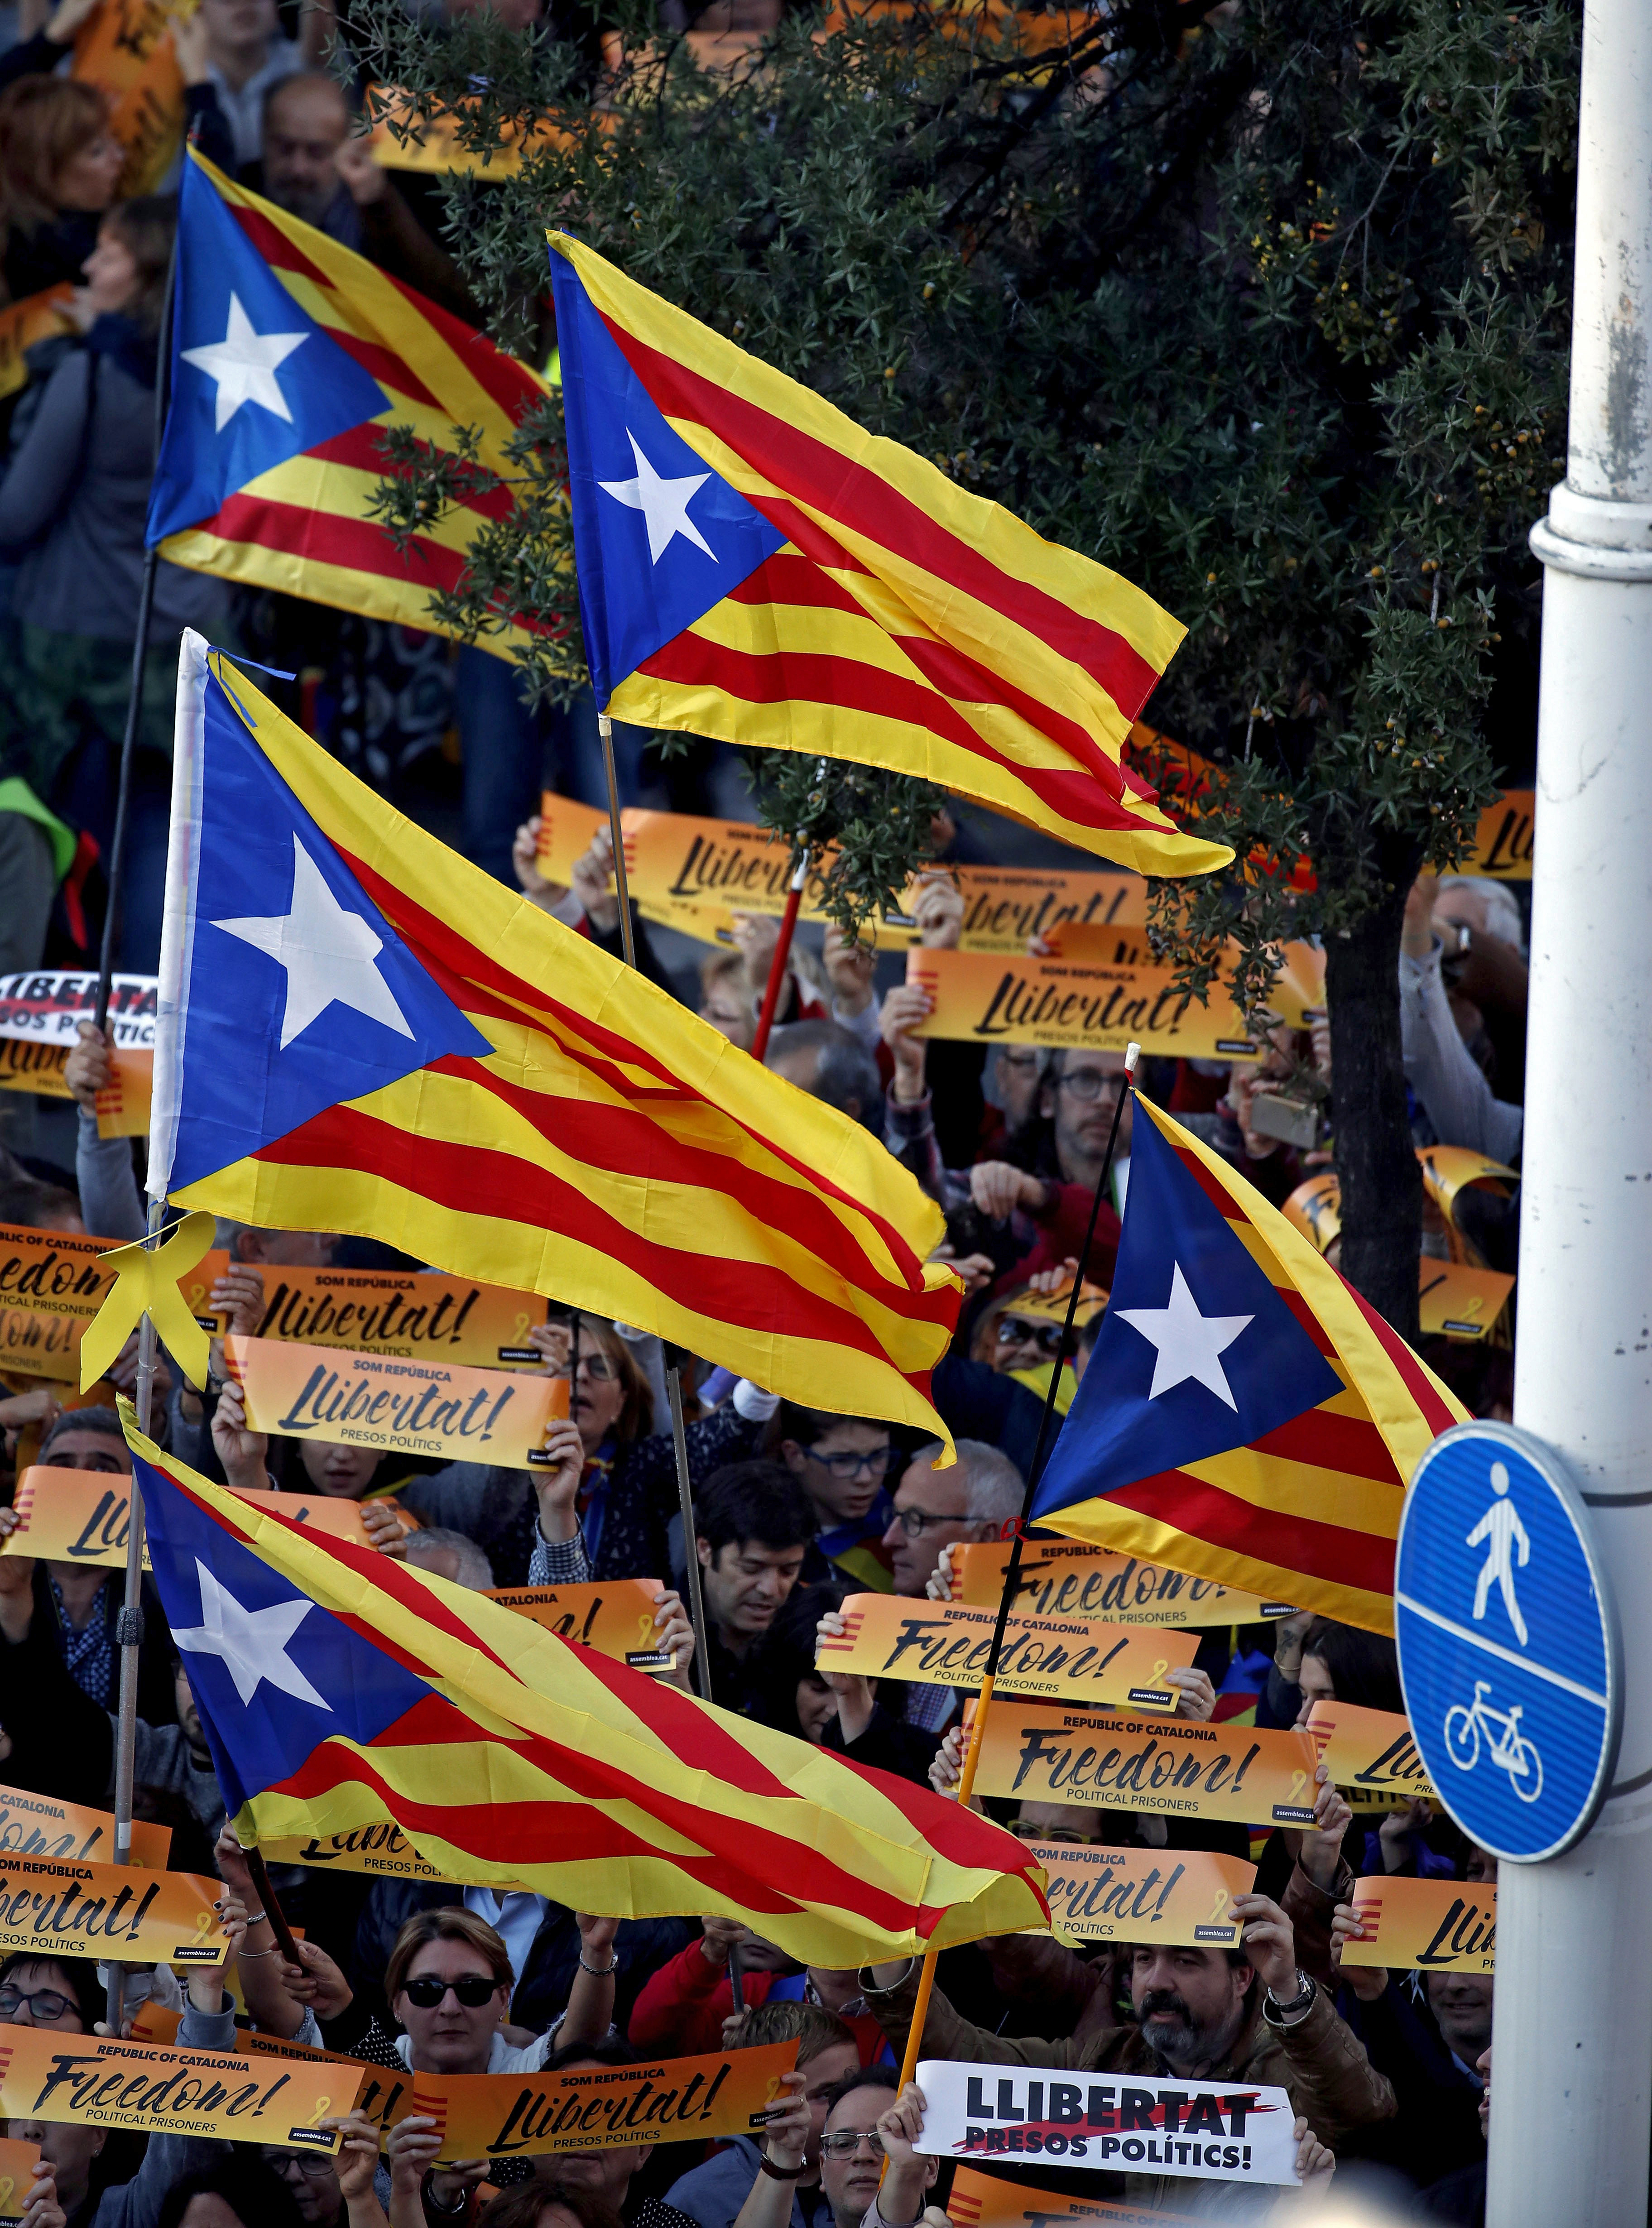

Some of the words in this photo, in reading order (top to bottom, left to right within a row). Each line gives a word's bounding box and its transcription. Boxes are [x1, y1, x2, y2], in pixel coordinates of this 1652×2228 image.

[26, 1236, 43, 1245] OF
[315, 1275, 344, 1287] SOM
[347, 1276, 415, 1290] REPÚBLICA
[353, 1359, 382, 1373] SOM
[385, 1364, 451, 1383] REPÚBLICA
[278, 1364, 515, 1442] Llibertat!
[341, 1428, 386, 1444] PRESOS
[389, 1435, 442, 1451] POLÍTICS
[1041, 1546, 1102, 1558] REPUBLIC
[489, 1593, 558, 1606] ATALONIA
[944, 1610, 997, 1624] REPUBLIC
[1006, 1618, 1020, 1628] OF
[1022, 1620, 1089, 1635] CATALONIA
[1119, 1612, 1187, 1623] PRISONERS
[629, 1653, 668, 1663] assemblea.cat
[882, 1620, 1129, 1679] Freedom!
[934, 1671, 984, 1684] POLITICA
[994, 1678, 1060, 1692] PRISONERS
[1132, 1692, 1169, 1702] assemblea.cat
[1063, 1716, 1124, 1732] REPUBLIC
[1126, 1723, 1143, 1733] OF
[1146, 1724, 1217, 1742] CATALONIA
[1011, 1729, 1261, 1793] Freedom!
[0, 1794, 65, 1820] CATALONIA
[1067, 1788, 1128, 1804] POLITICAL
[1131, 1795, 1199, 1811] PRISONERS
[1276, 1810, 1314, 1819] assemblea.cat
[364, 1858, 411, 1873] PRESOS
[1061, 1851, 1126, 1865] REPÚBLICA
[23, 1862, 94, 1880] REPÚBLICA
[1046, 1863, 1186, 1923] ertat!
[1064, 1921, 1114, 1935] POLÍTICS
[30, 1936, 86, 1952] POLÍTICS
[250, 2039, 279, 2055] SOM
[97, 2045, 158, 2061] REPUBLIC
[159, 2052, 178, 2063] OF
[179, 2055, 250, 2072] CATALONIA
[32, 2055, 291, 2118] Freedom!
[561, 2077, 592, 2087] SOM
[595, 2068, 665, 2084] REPÚBLICA
[486, 2063, 731, 2154] Llibertat!
[967, 2076, 1255, 2138] LLIBERTAT
[86, 2109, 146, 2125] POLITICAL
[149, 2116, 217, 2132] PRISONERS
[293, 2132, 331, 2142] assemblea.cat
[553, 2136, 601, 2148] PRESOS
[605, 2130, 661, 2144] POLÍTICS
[966, 2126, 1088, 2157] PRESOS
[1101, 2134, 1252, 2170] POLÍTICS!
[1069, 2204, 1135, 2223] REPUBLIC
